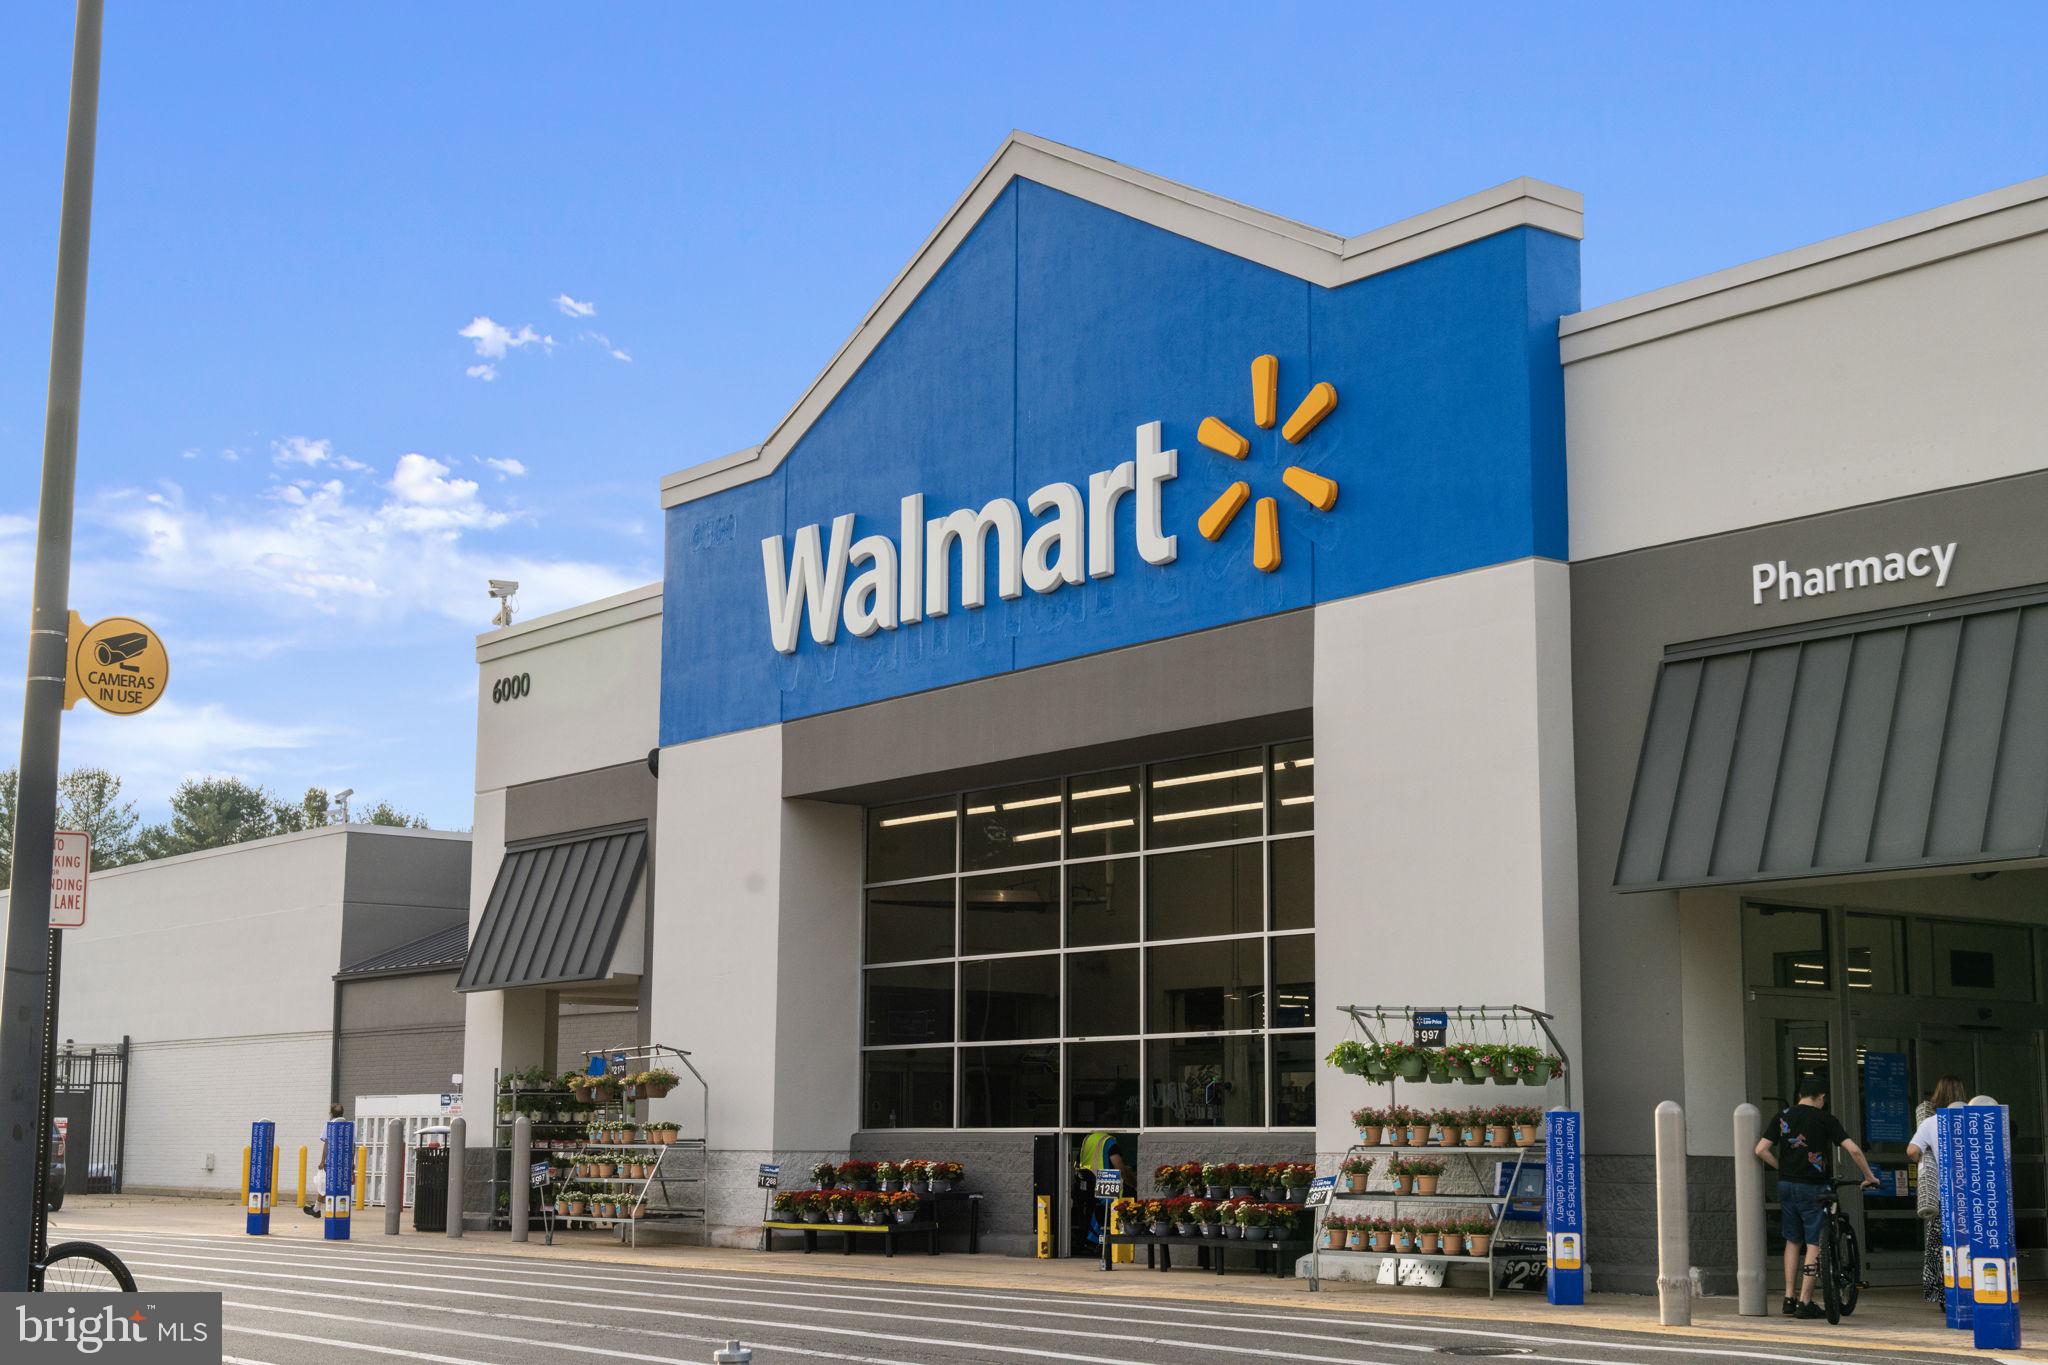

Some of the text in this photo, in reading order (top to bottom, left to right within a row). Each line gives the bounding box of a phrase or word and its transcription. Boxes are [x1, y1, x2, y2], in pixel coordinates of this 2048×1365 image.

[761, 419, 1178, 655] Walmart
[1752, 542, 1958, 605] Pharmacy
[88, 671, 155, 690] CAMERAS
[100, 687, 143, 704] IN USE
[492, 672, 531, 704] 6000
[54, 893, 81, 910] LANE
[1554, 1117, 1565, 1222] free pharmacy delivery
[1565, 1116, 1577, 1226] Walmart+ members get
[1952, 1114, 1969, 1235] free pharmacy delivery
[1967, 1112, 1984, 1244] free pharmacy delivery
[1983, 1112, 2001, 1249] Walmart+ members get
